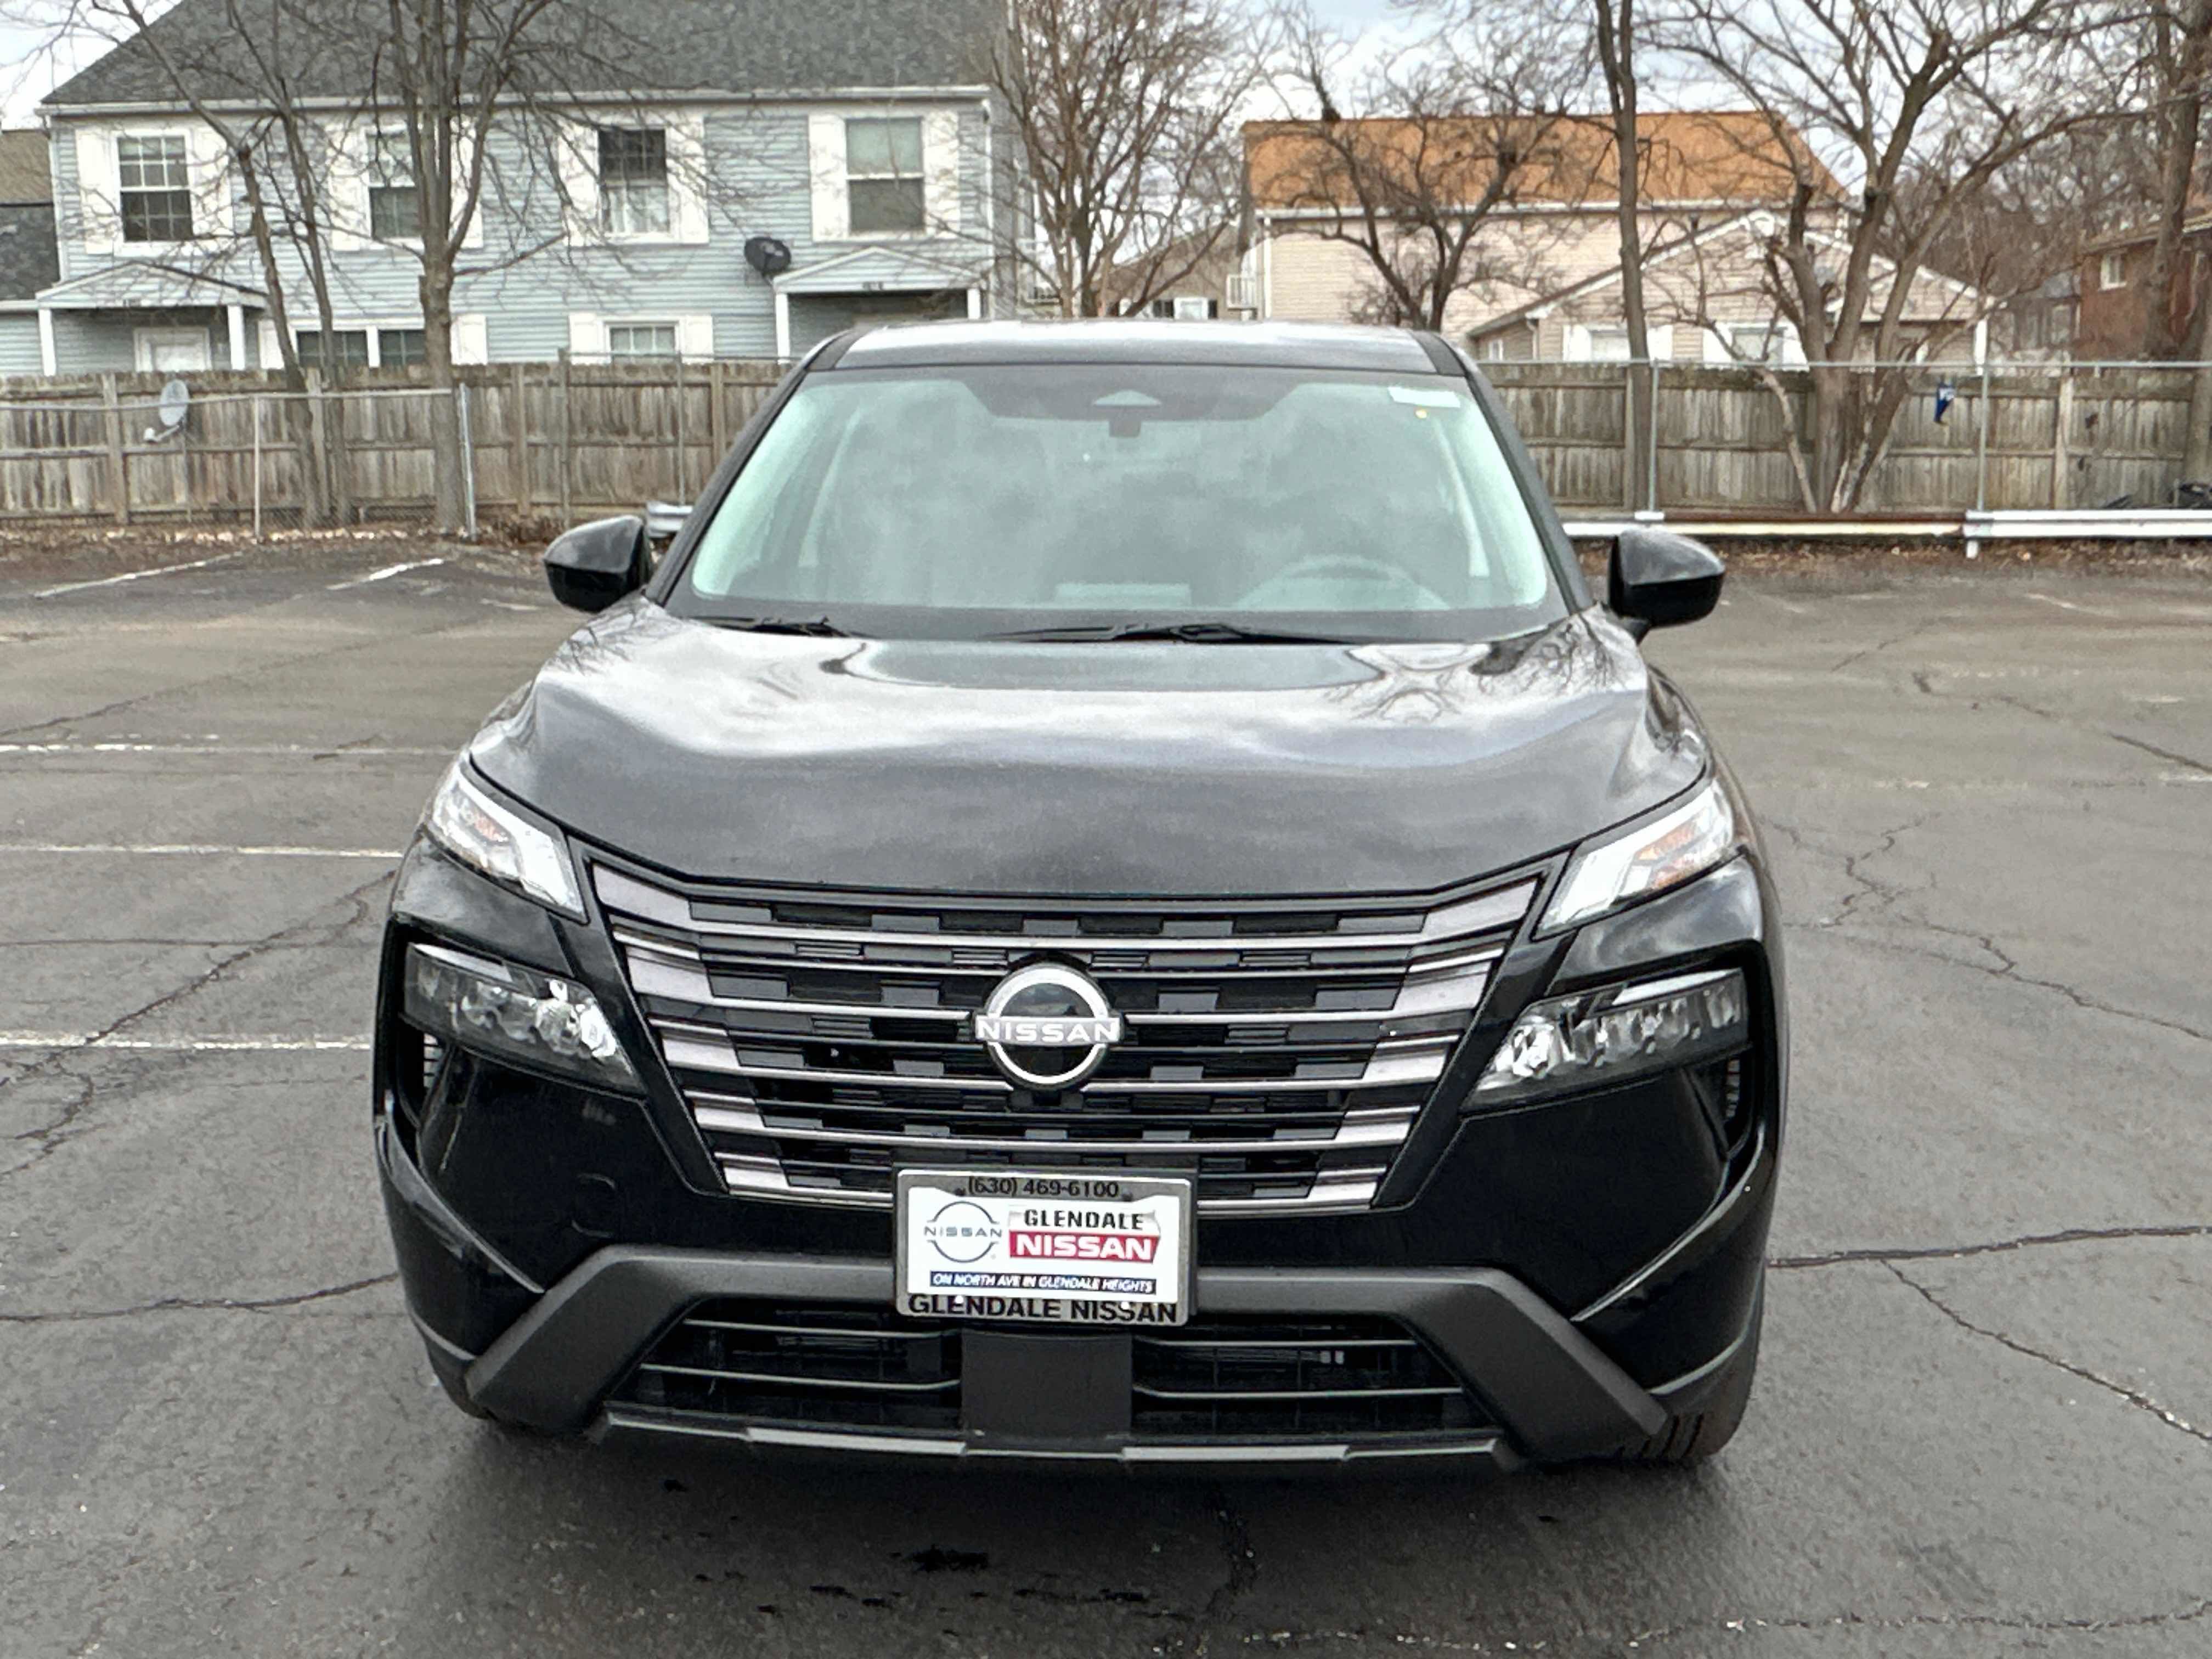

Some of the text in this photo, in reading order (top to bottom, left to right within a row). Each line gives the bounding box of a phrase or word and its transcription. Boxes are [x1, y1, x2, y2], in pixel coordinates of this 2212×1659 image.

[977, 1019, 1119, 1042] NISSAN
[969, 1176, 1119, 1198] (630) 469-6100
[1024, 1209, 1144, 1230] GLENDALE
[924, 1226, 1002, 1238] NISSAN
[1016, 1233, 1152, 1260] NISSAN
[933, 1273, 1153, 1293] ON NORTH AVE IN GLENDALE HEIGHTS
[909, 1294, 1176, 1322] GLENDALE NISSAN
